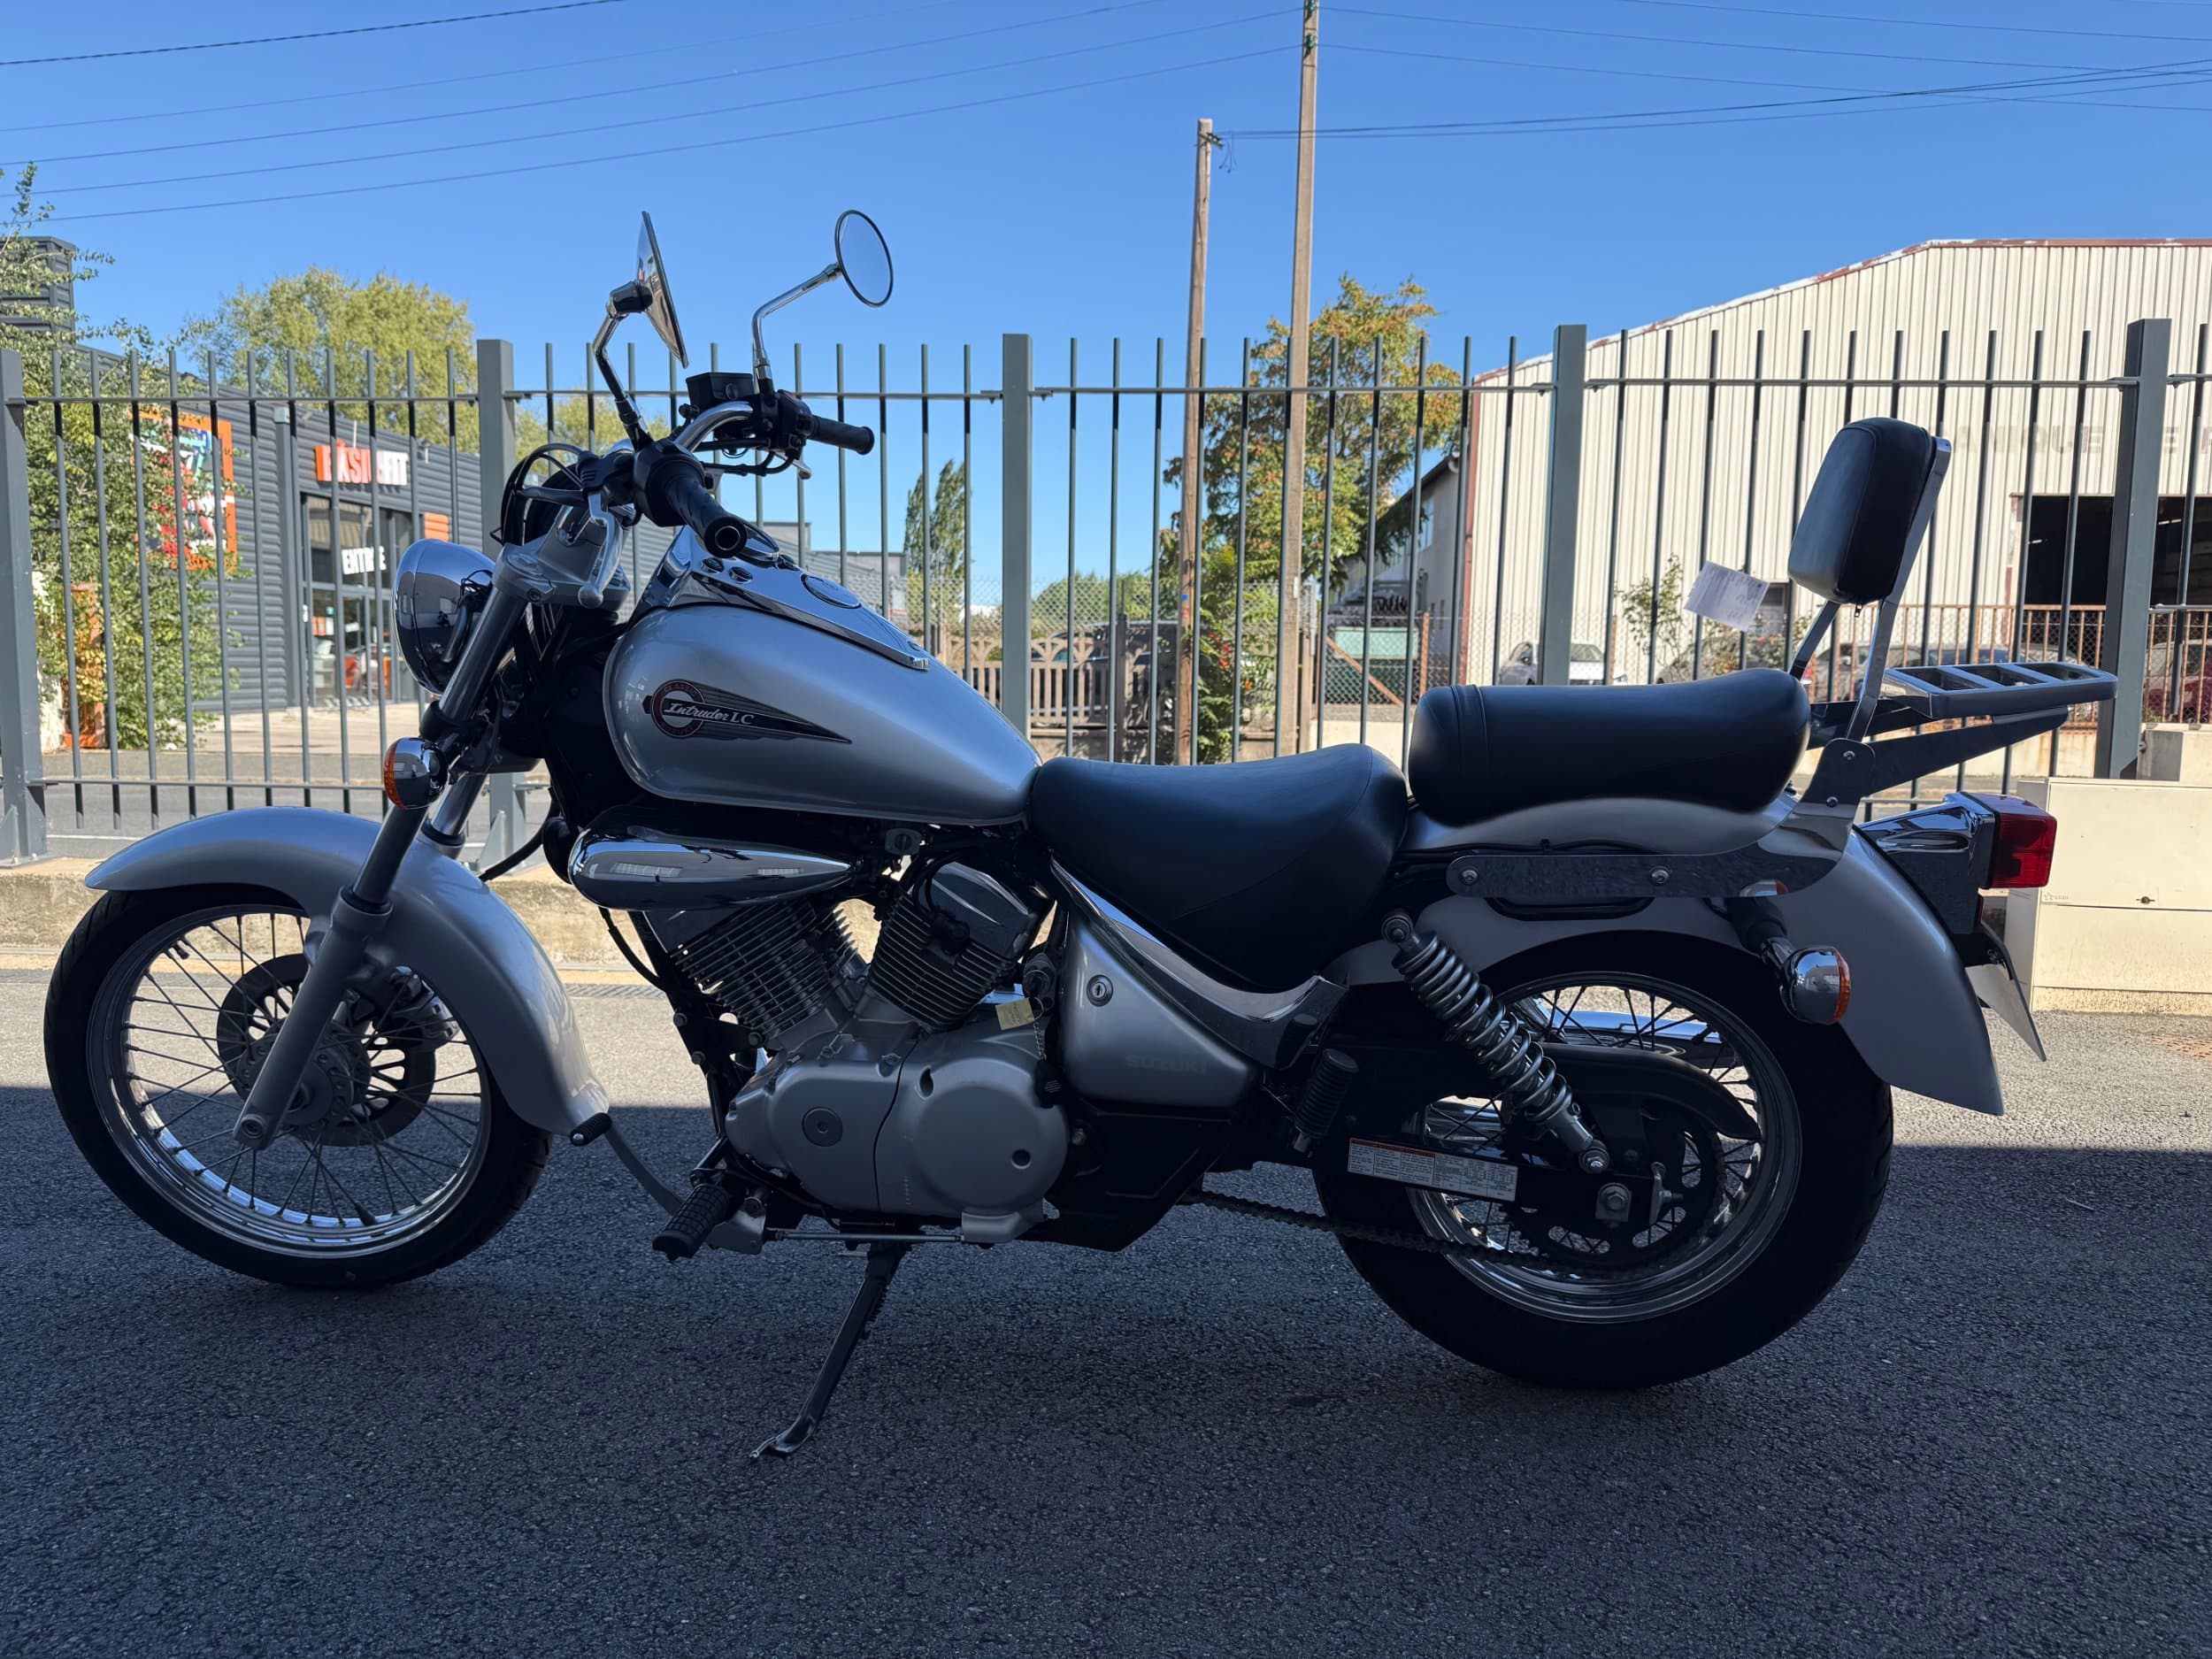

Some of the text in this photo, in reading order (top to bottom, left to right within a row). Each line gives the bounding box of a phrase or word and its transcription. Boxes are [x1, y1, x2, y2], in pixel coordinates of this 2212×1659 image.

[664, 702, 755, 725] Intruder LC
[1125, 1054, 1208, 1076] SUZUKI
